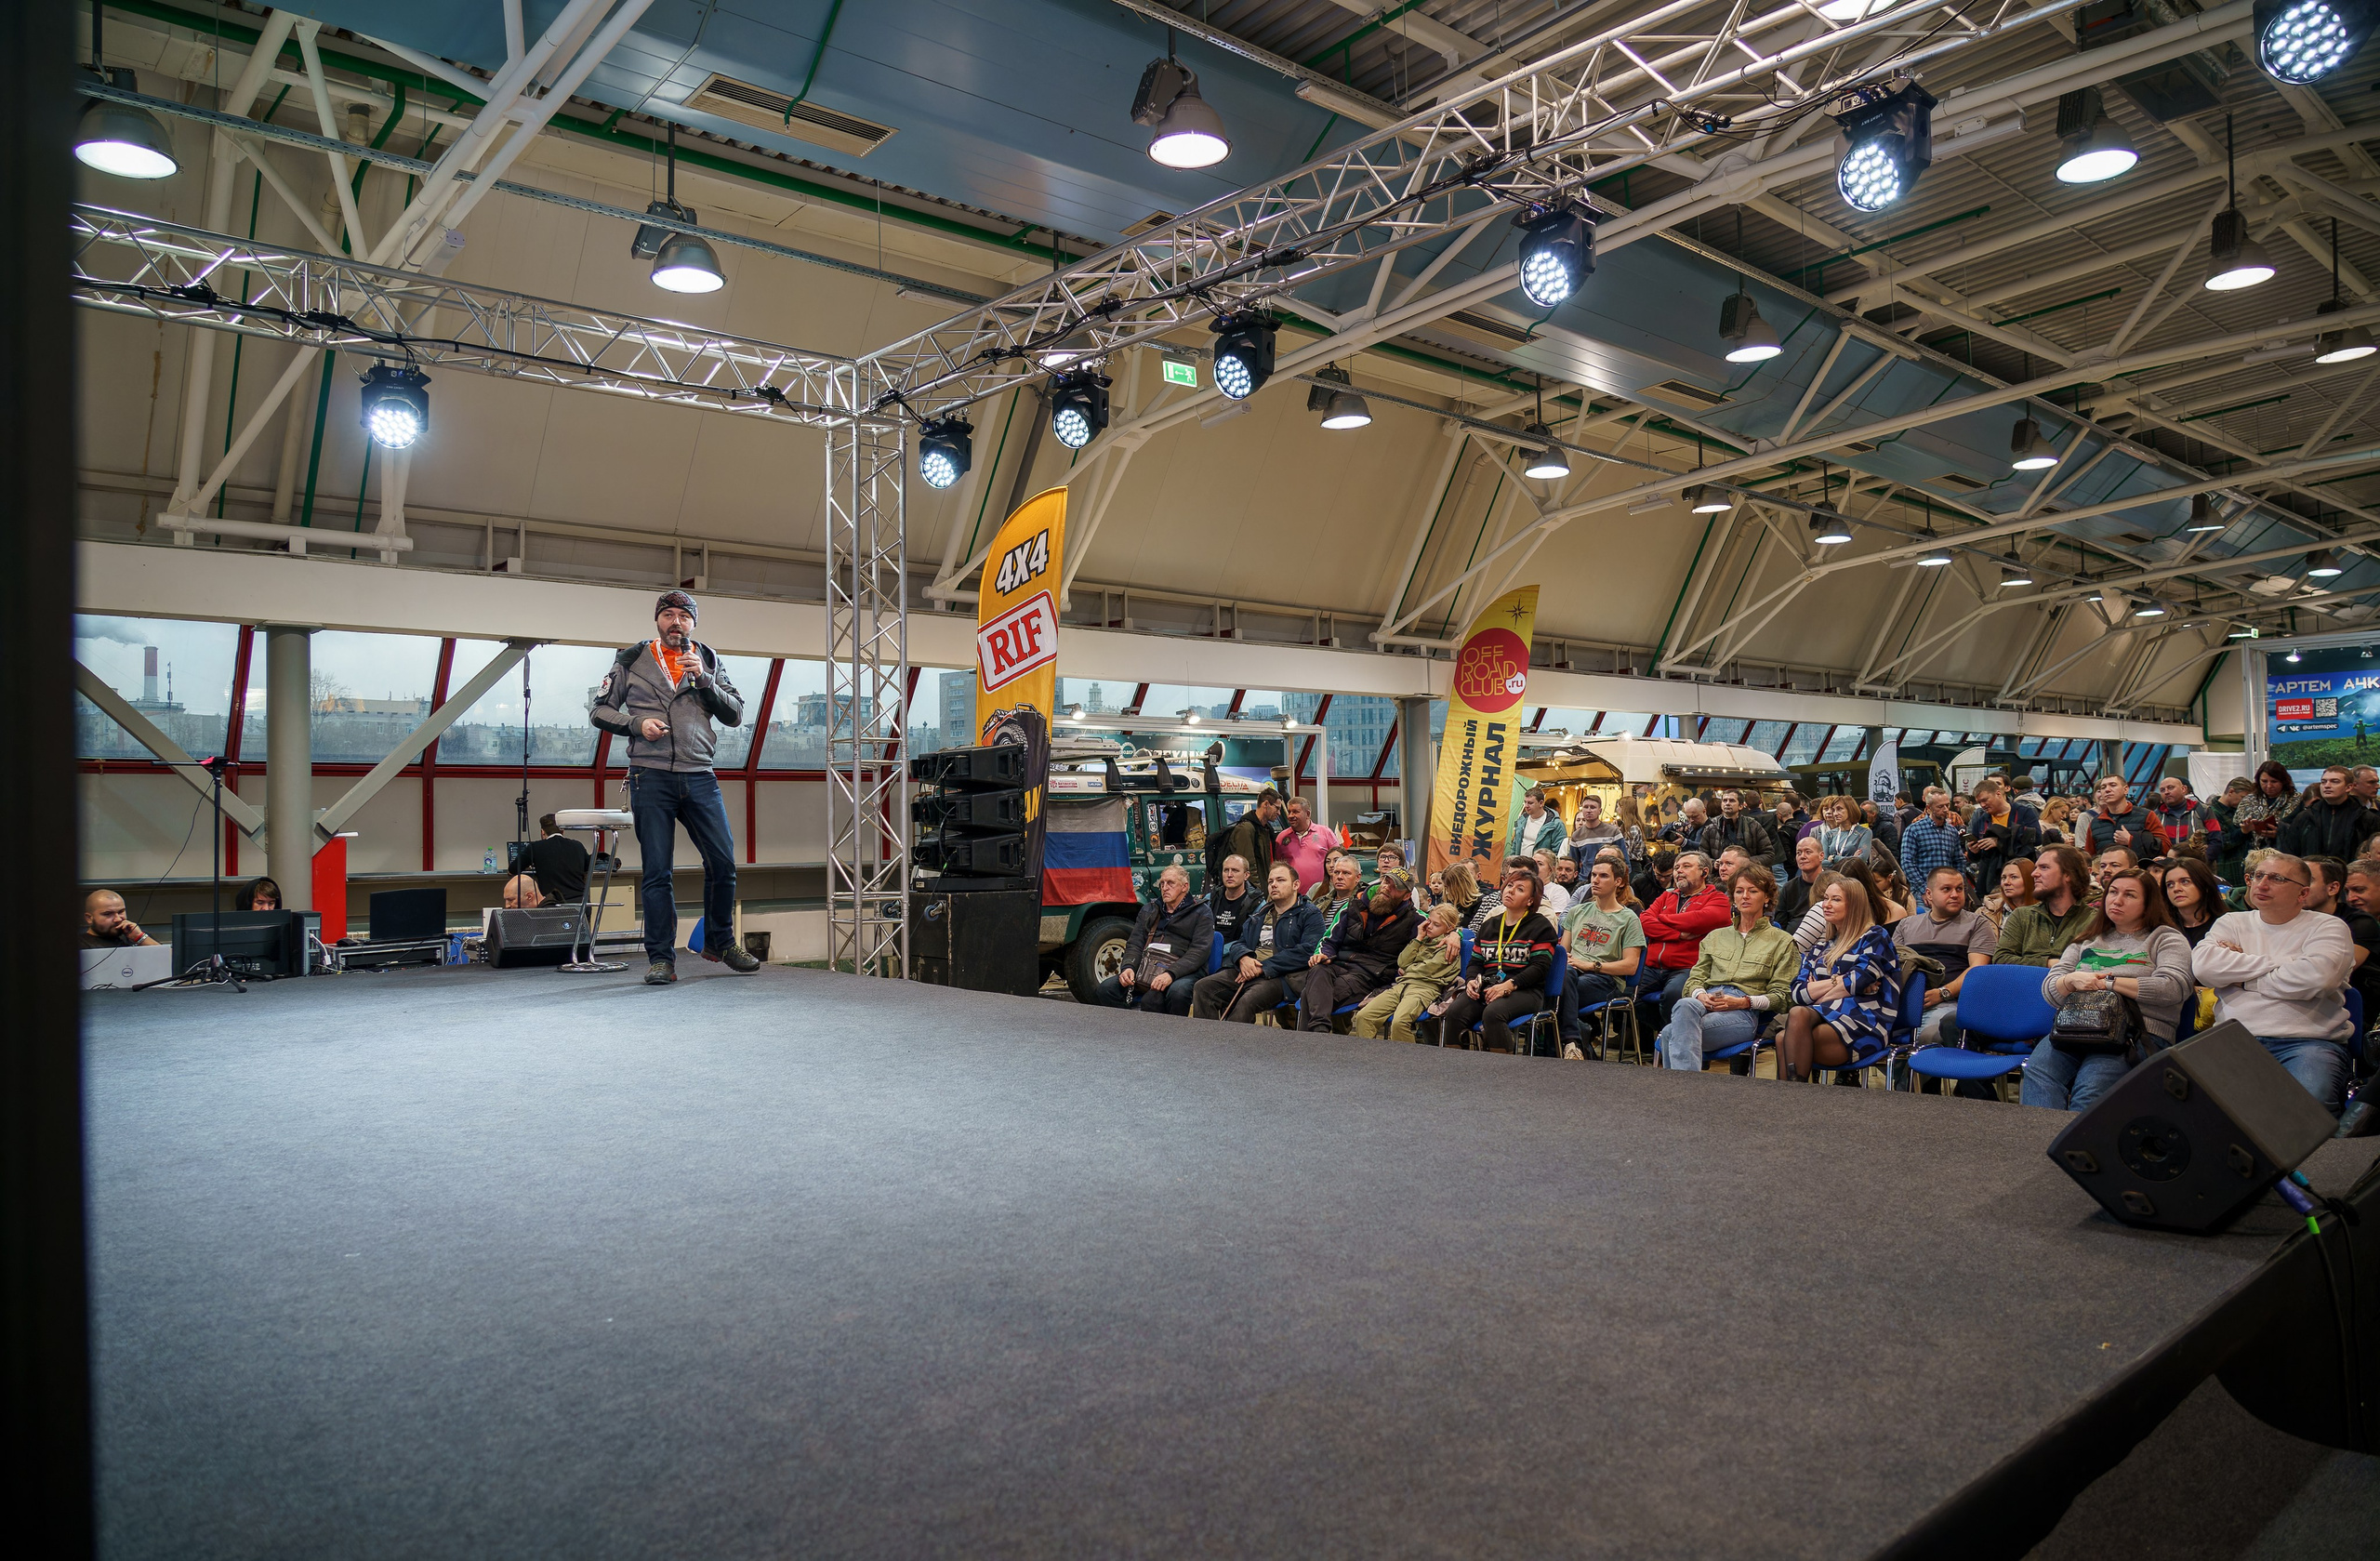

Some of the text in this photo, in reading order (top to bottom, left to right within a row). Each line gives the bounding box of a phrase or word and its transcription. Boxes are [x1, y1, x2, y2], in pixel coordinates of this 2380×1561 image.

[995, 528, 1050, 597] 4X4
[987, 608, 1042, 676] RIF
[1463, 645, 1504, 665] OFF
[1461, 661, 1517, 681] ROAD
[1461, 678, 1524, 696] CLUB .ru
[2275, 680, 2332, 694] АРТЕМ
[2278, 704, 2310, 713] DRIVE2.RU
[1449, 720, 1478, 856] ВНЕДОРОЖНЫЙ
[1472, 722, 1507, 861] ЖУРНАЛ
